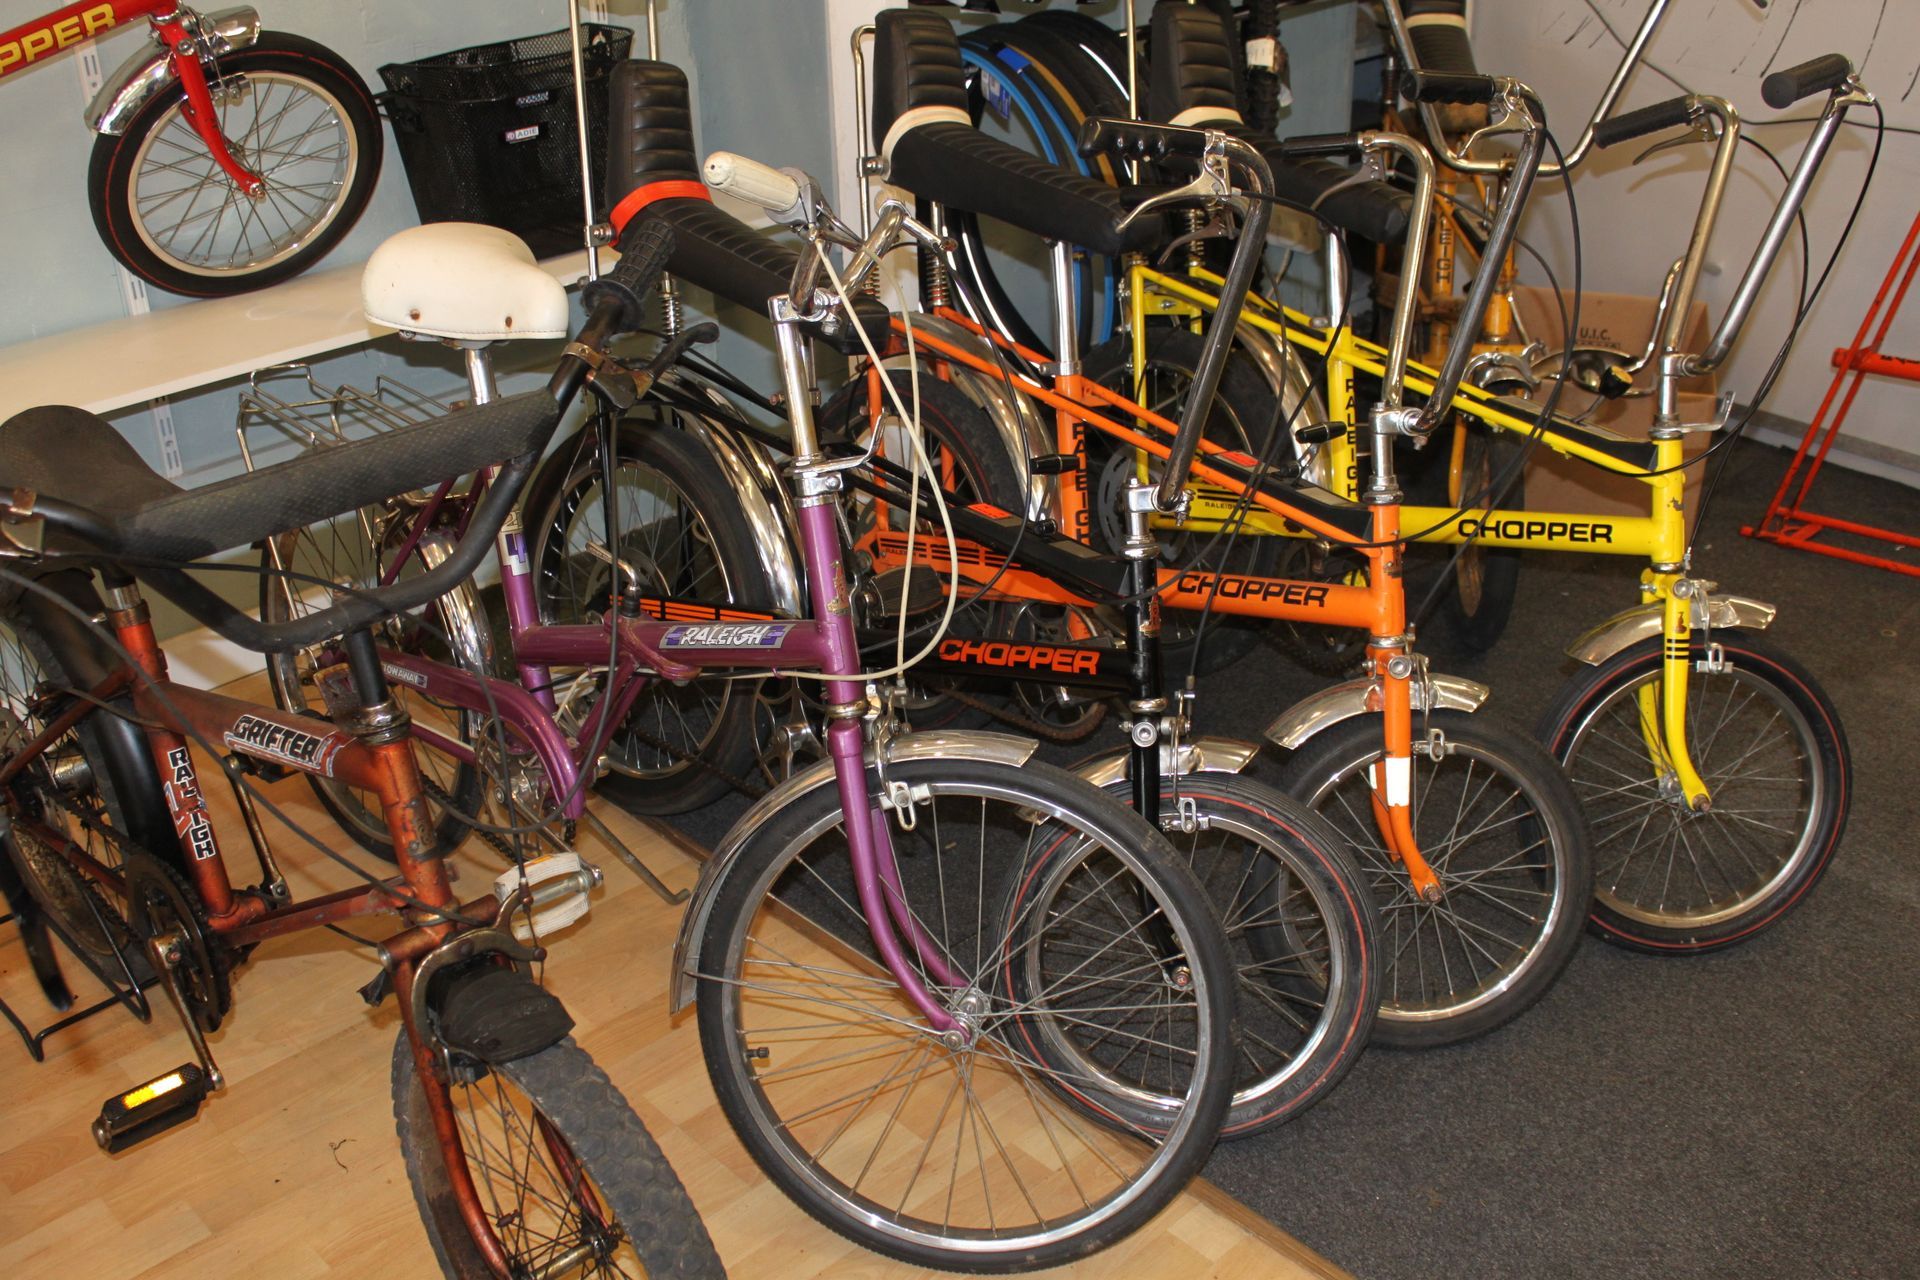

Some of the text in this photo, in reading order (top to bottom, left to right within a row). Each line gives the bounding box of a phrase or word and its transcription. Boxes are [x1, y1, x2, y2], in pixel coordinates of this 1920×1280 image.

[1436, 214, 1453, 283] LEIGH
[1580, 327, 1611, 341] U.I.C.
[1345, 378, 1359, 498] RALEIGH
[1458, 519, 1614, 544] CHOPPER
[1177, 574, 1330, 608] CHOPPER
[680, 625, 770, 646] RALEIGH
[382, 662, 419, 684] TOWAWAY
[938, 639, 1100, 675] CHOPPER
[233, 714, 322, 766] GRIFTER
[167, 746, 217, 860] RALIGH
